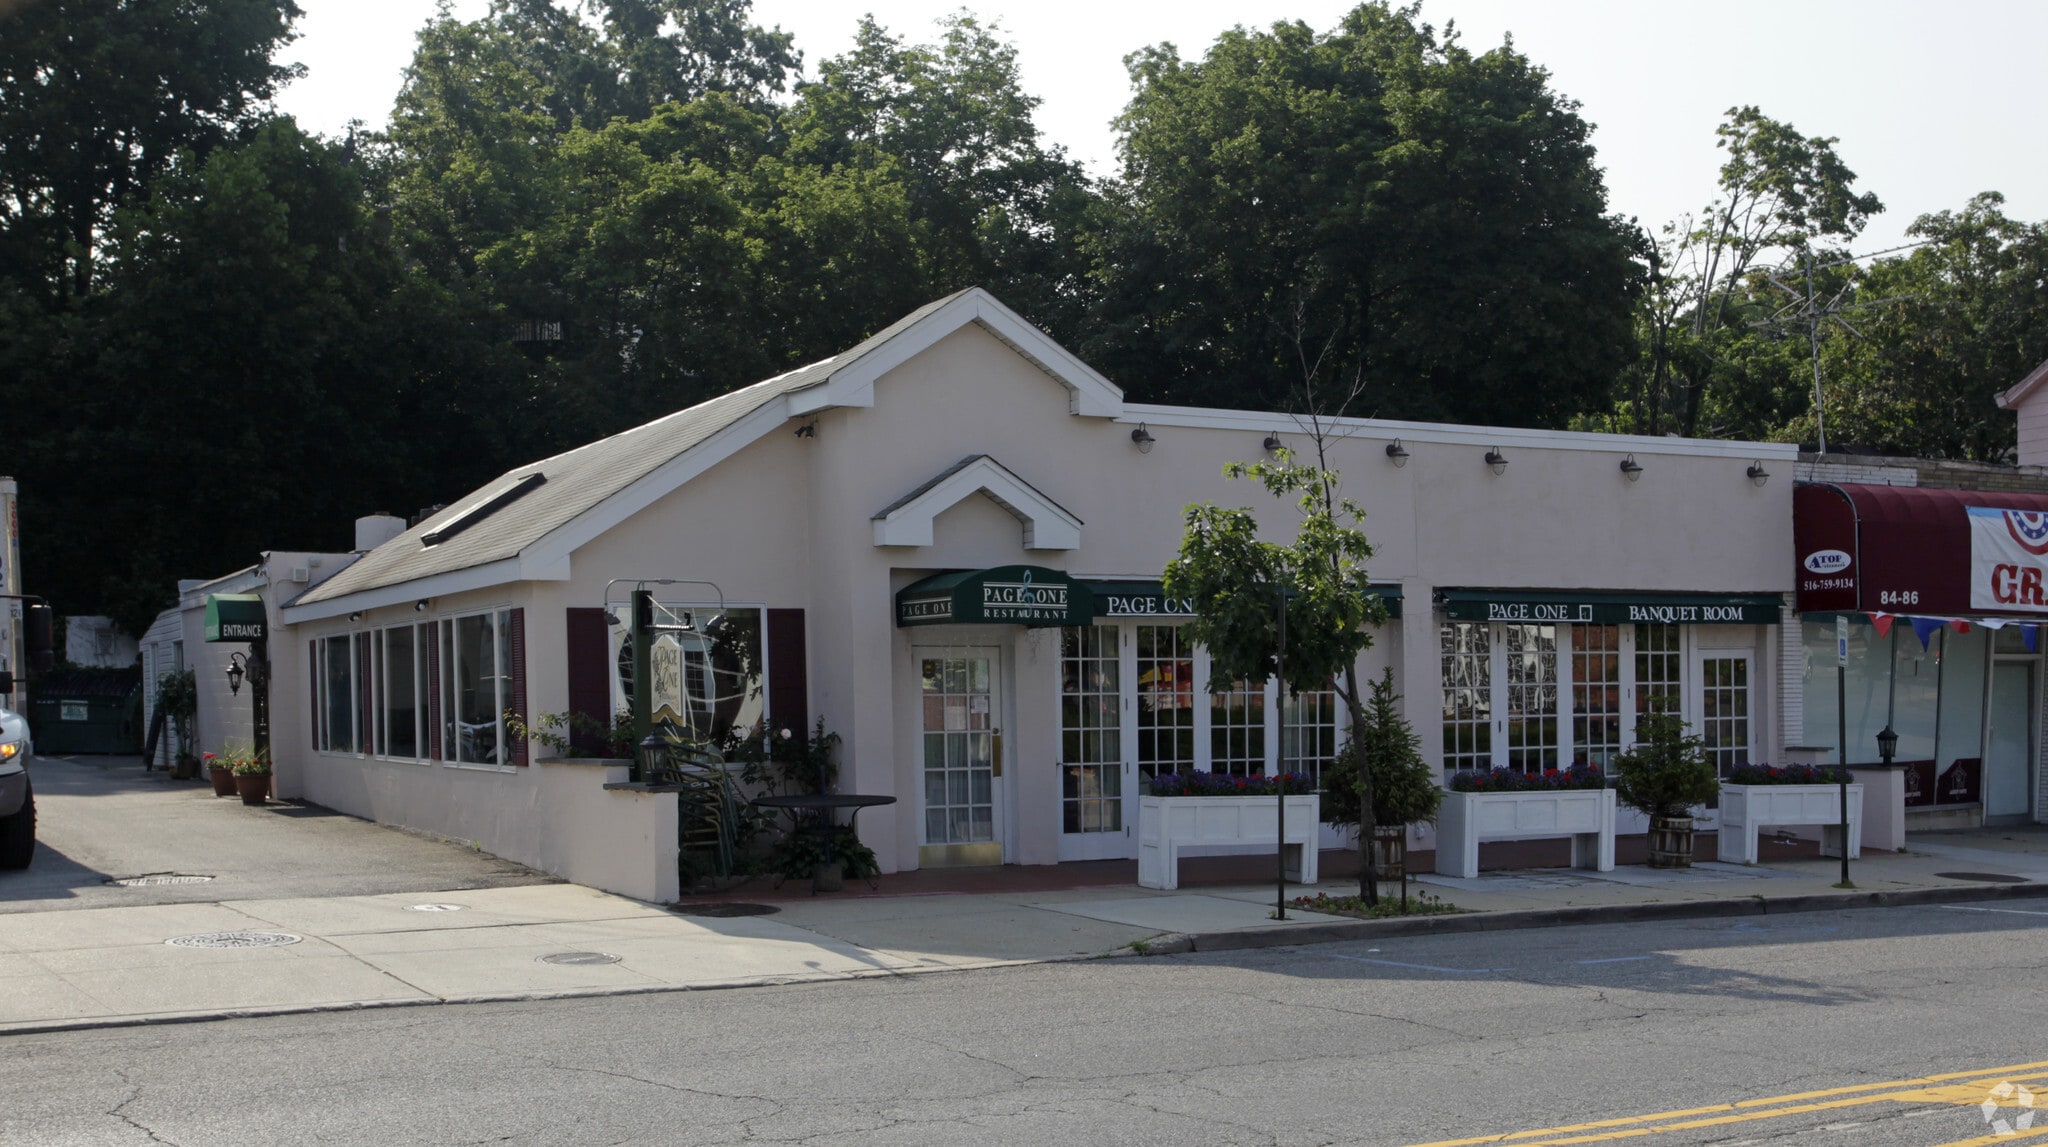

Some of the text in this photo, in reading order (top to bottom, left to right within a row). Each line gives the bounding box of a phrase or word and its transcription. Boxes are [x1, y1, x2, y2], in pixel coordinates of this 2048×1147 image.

[1804, 578, 1854, 591] 516-759-9134
[1991, 563, 2048, 606] GR
[983, 588, 1068, 604] PAGE ONE
[1880, 591, 1919, 605] 84-86
[902, 602, 953, 616] PAGE ONE
[1107, 596, 1194, 614] PAGE ON
[1488, 603, 1568, 619] PAGE ONE
[983, 609, 1069, 619] RESTAURANT
[1629, 605, 1744, 623] BANQUET ROOM
[223, 624, 262, 637] ENTRANCE
